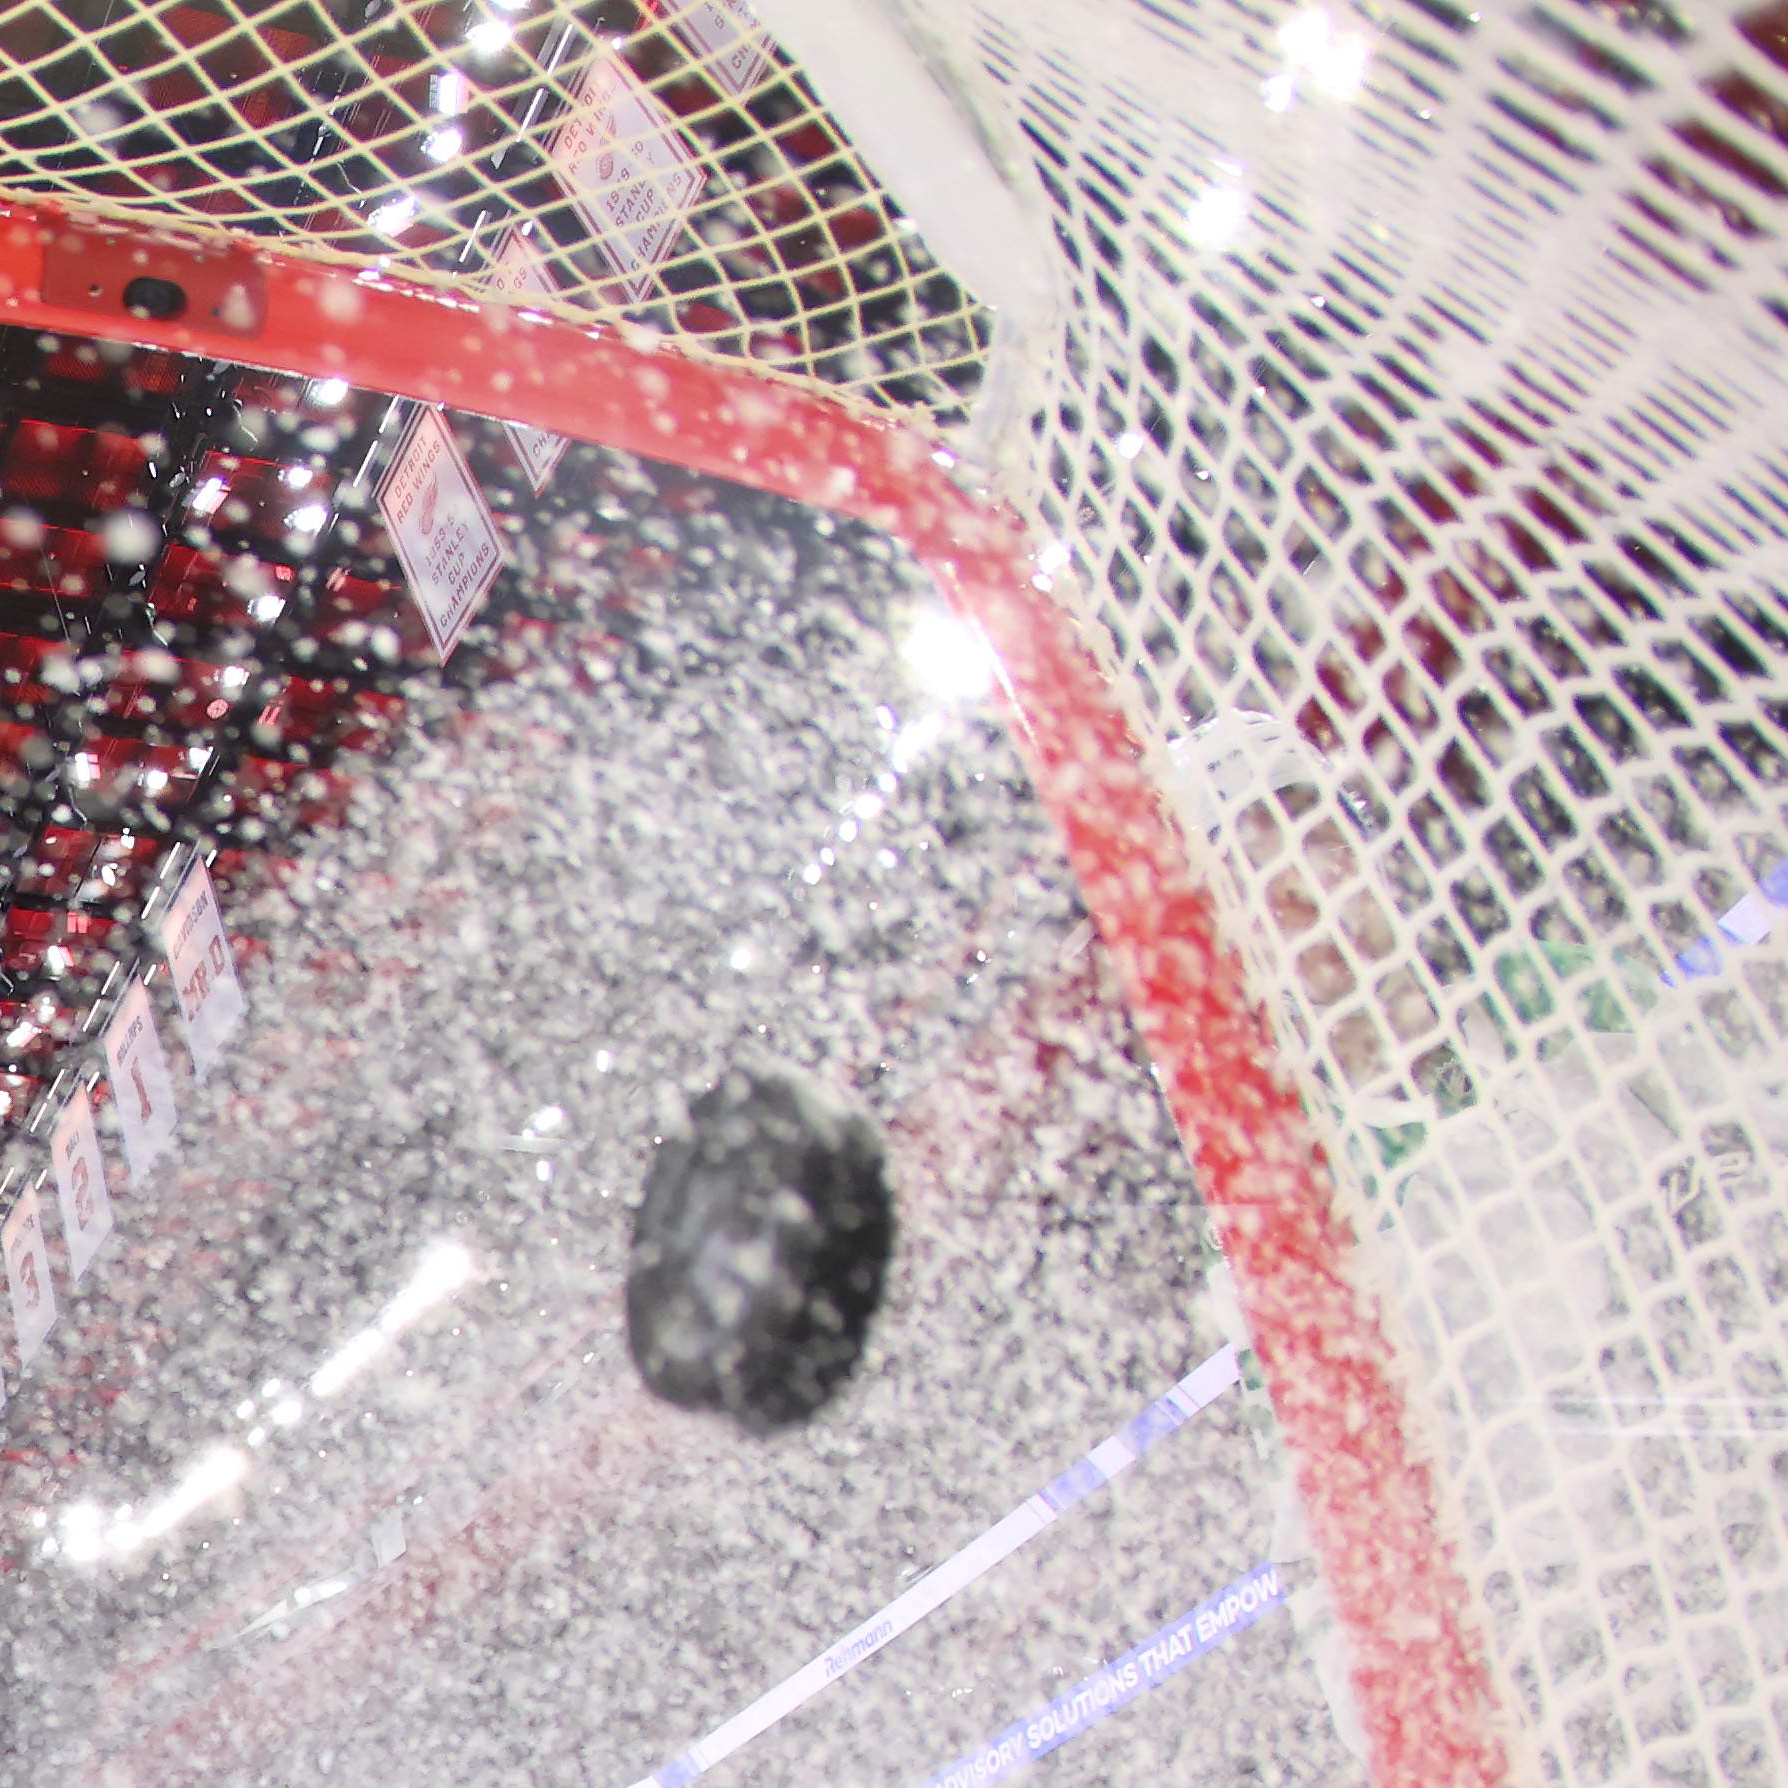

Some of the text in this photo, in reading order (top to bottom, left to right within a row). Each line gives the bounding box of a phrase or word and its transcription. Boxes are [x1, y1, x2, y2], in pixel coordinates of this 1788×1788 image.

[440, 543, 489, 628] CHAMPIONS
[448, 554, 465, 586] CUP
[823, 1618, 894, 1679] Rehmann
[1025, 1664, 1139, 1751] SOLUTIONS
[1137, 1629, 1196, 1679] THAT
